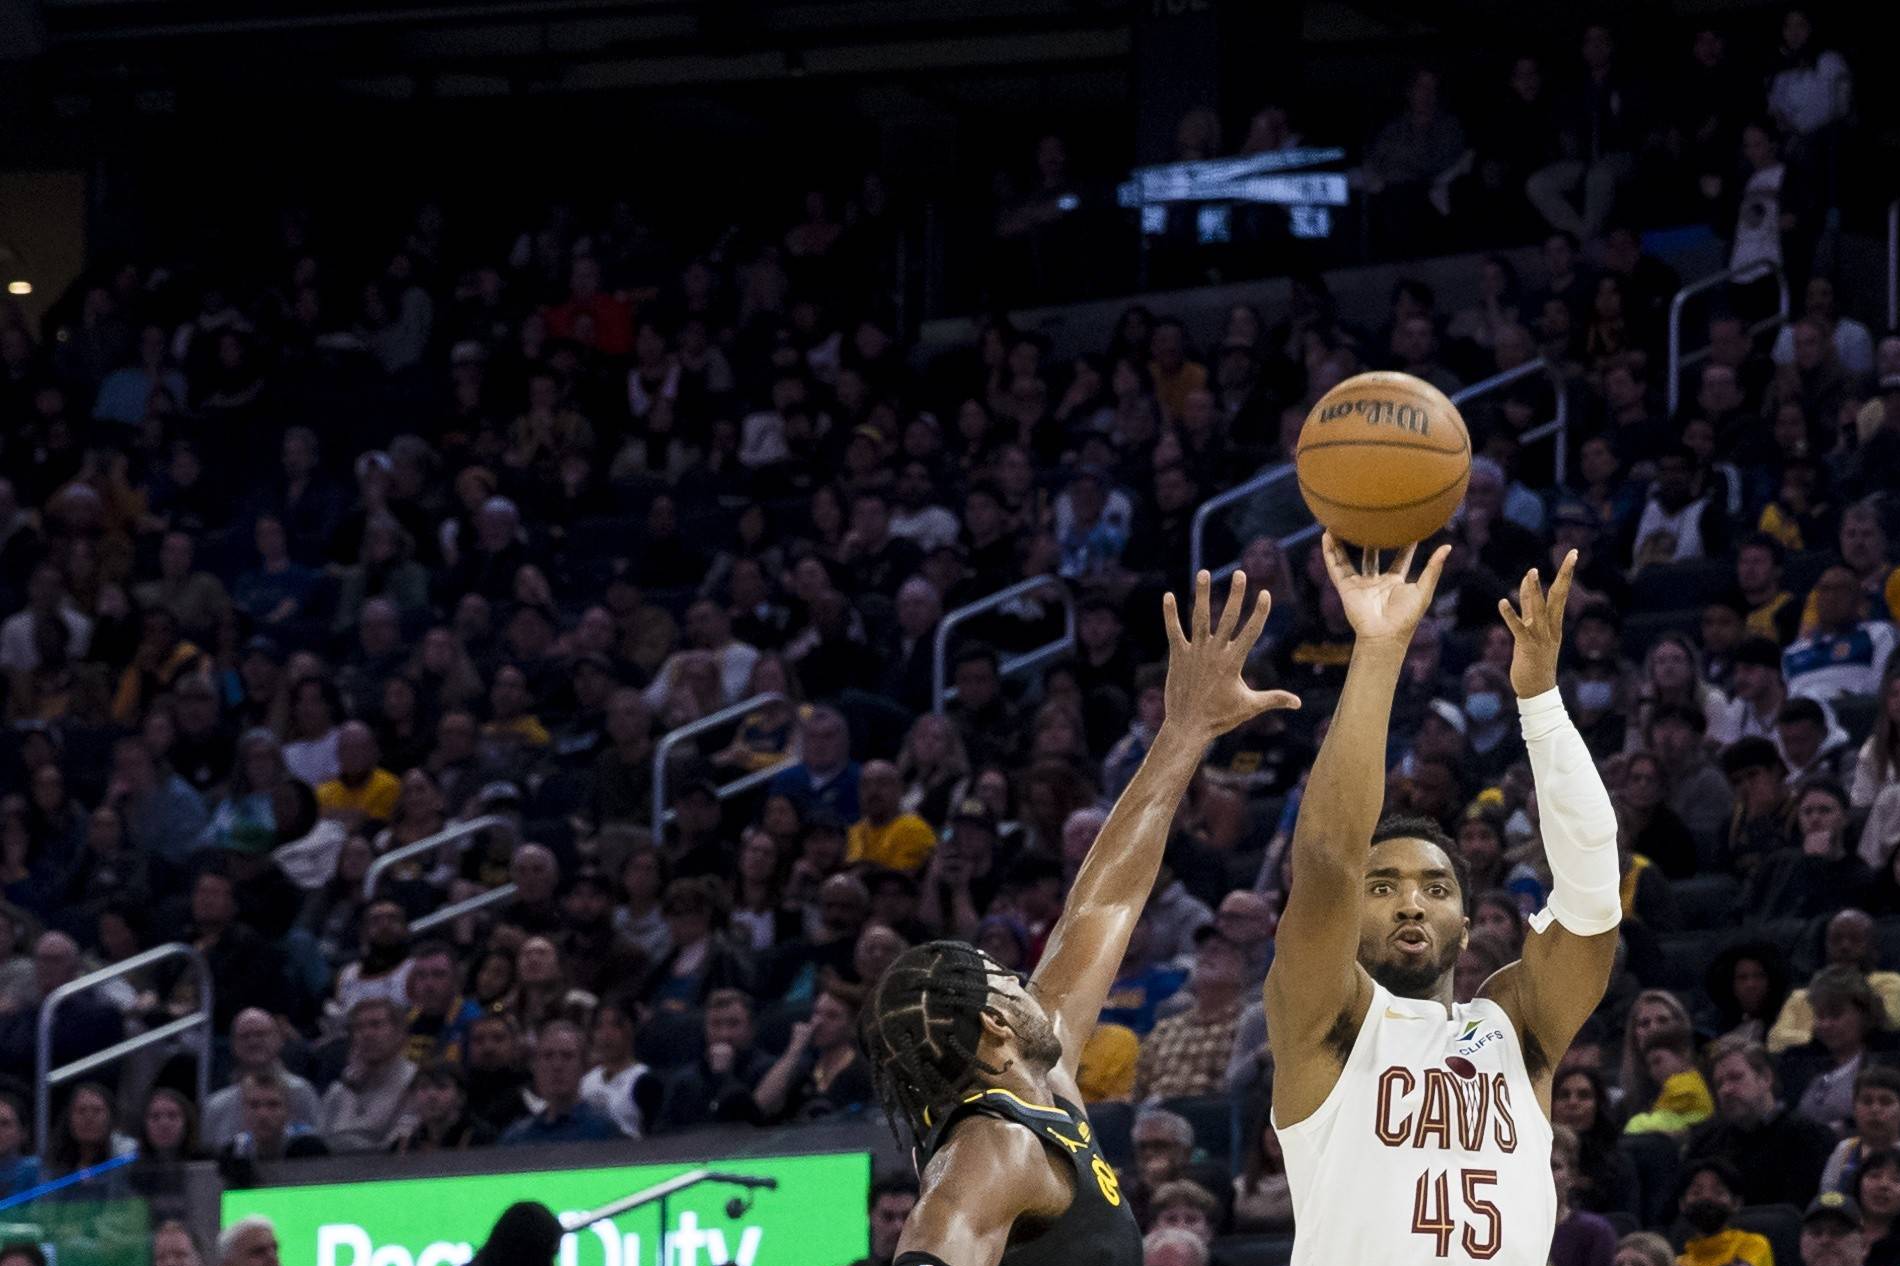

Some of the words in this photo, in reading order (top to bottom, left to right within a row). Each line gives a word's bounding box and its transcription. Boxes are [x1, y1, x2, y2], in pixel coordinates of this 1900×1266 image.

[1458, 1029, 1505, 1057] CLIFFS
[1374, 1065, 1518, 1154] CAVS
[1411, 1167, 1503, 1260] 45
